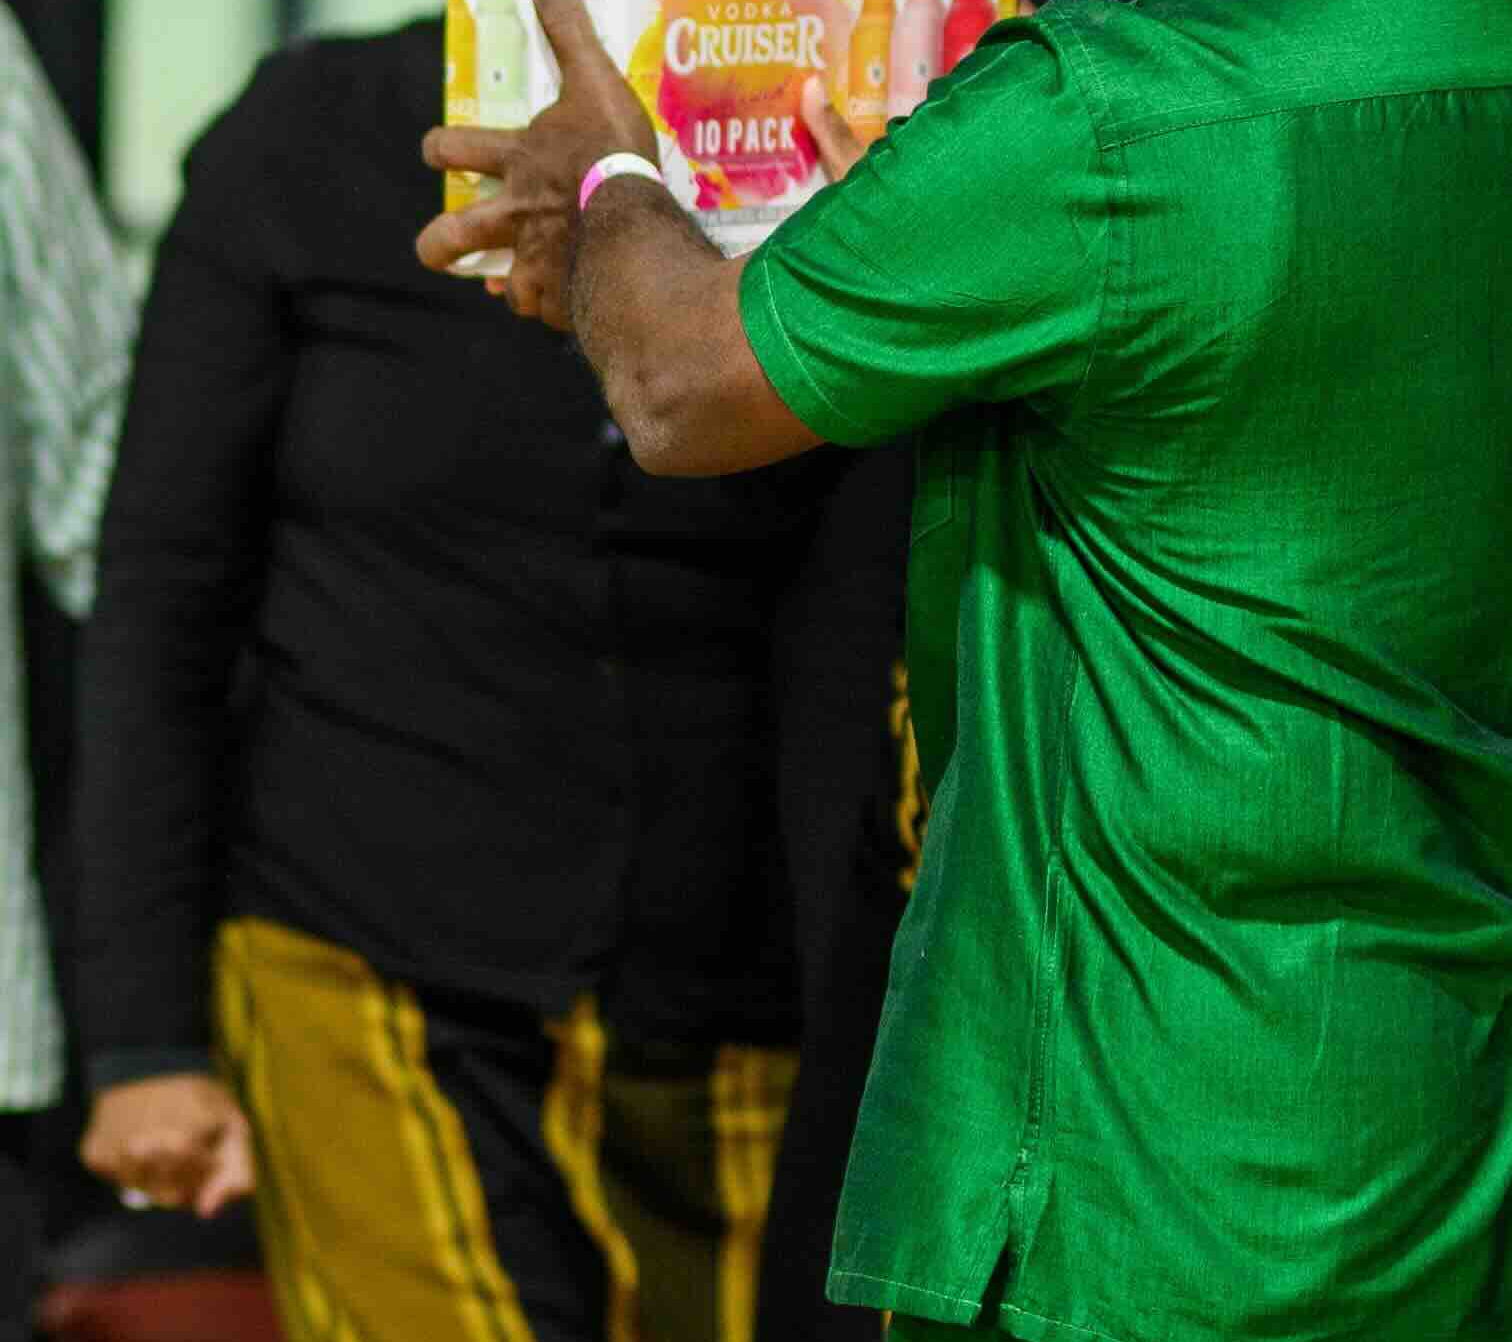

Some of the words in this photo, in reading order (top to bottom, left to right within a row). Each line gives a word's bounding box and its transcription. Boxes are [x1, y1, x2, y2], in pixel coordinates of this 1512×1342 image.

[706, 1, 793, 19] VODKA
[665, 13, 825, 75] CRUISER
[695, 118, 721, 155] 10
[728, 116, 796, 154] PACK
